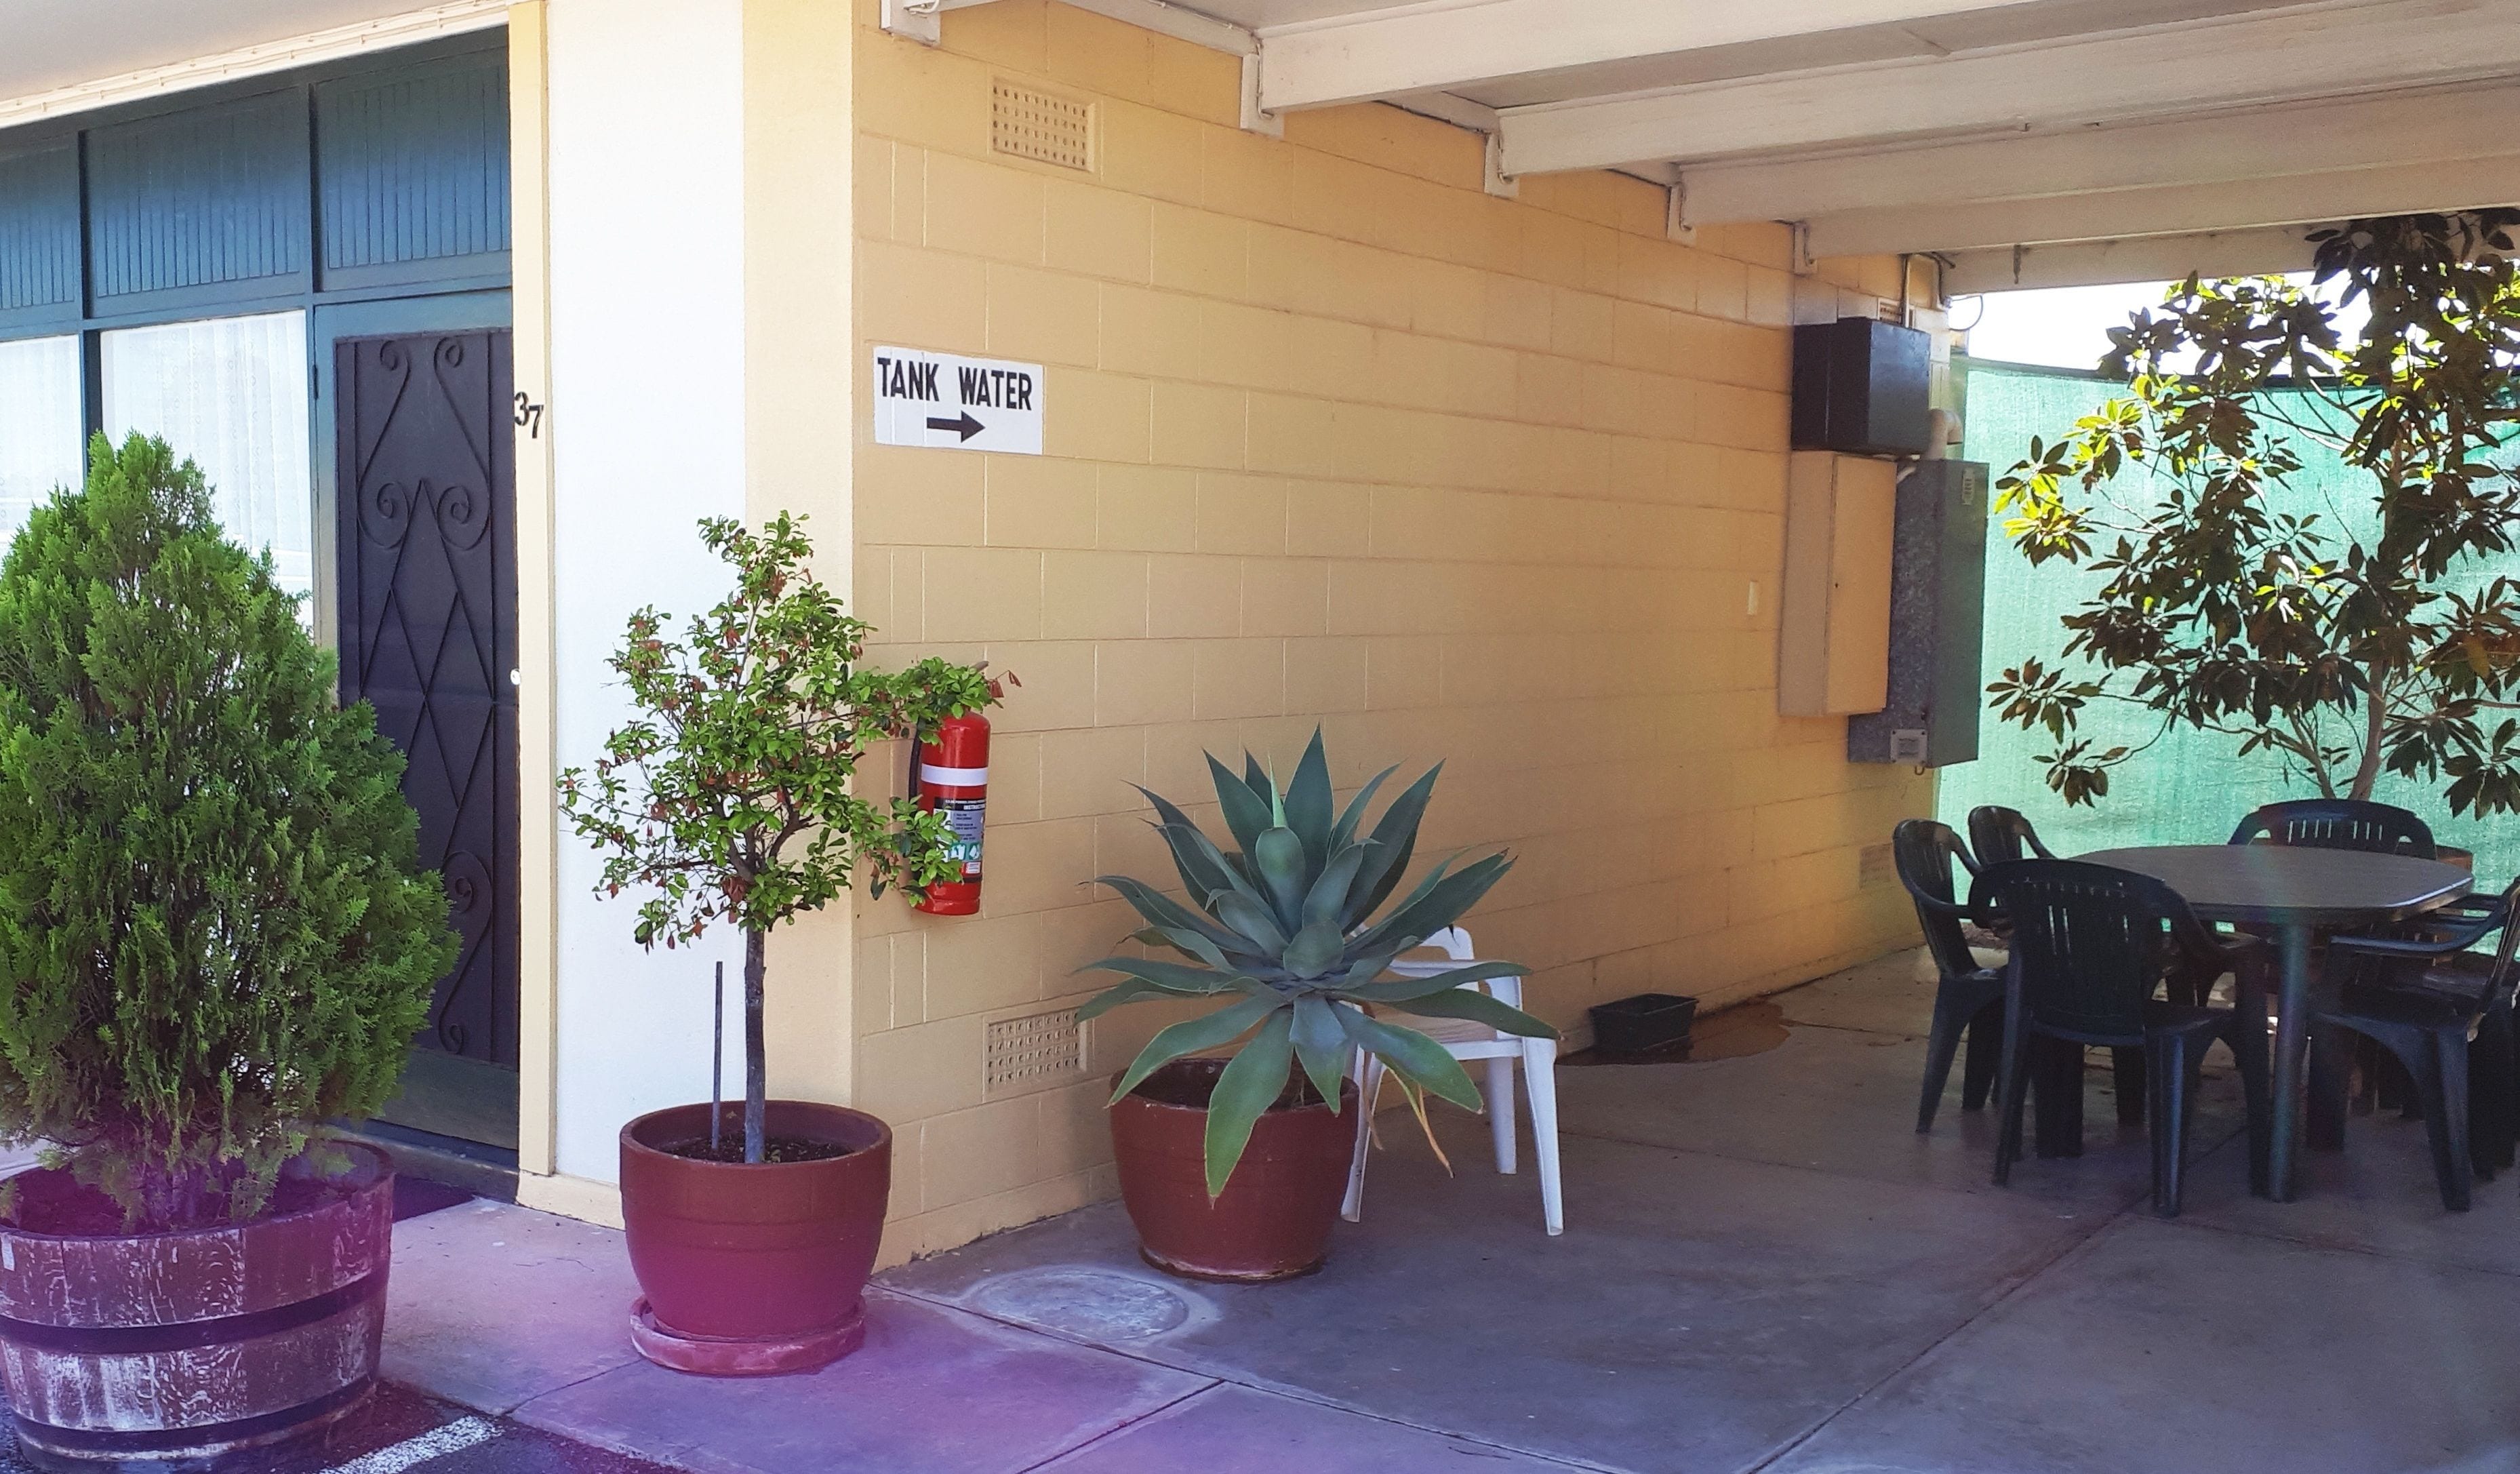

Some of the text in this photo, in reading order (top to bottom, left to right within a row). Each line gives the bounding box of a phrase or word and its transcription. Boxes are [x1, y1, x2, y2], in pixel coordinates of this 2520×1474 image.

[877, 357, 1032, 411] TANK WATER
[515, 391, 544, 439] 37
